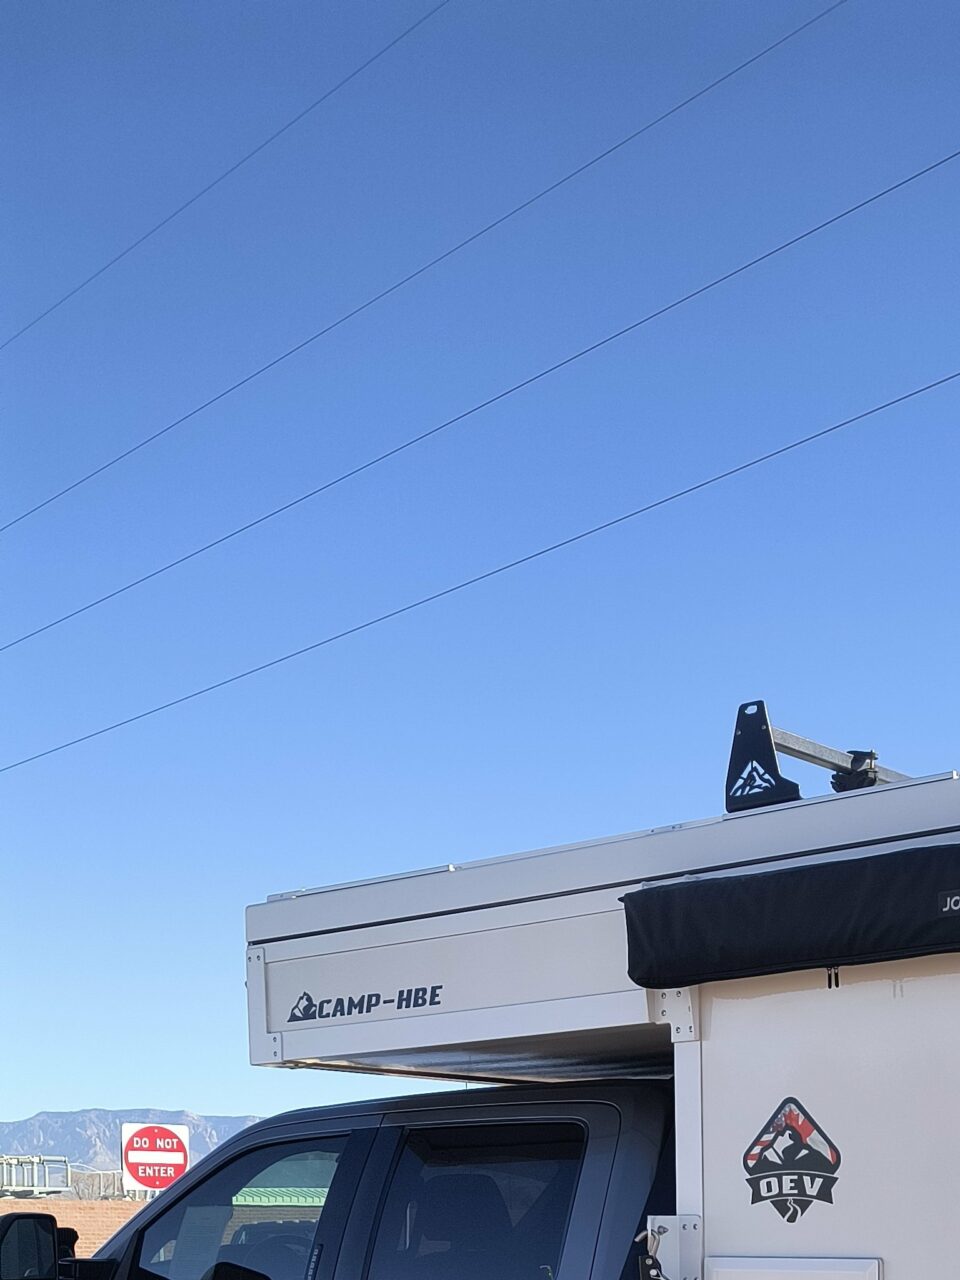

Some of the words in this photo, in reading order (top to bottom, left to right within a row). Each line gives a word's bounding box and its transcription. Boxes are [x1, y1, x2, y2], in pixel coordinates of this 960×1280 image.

[318, 985, 443, 1018] CAMP-HBE
[133, 1137, 149, 1148] DO
[156, 1138, 179, 1149] NOT
[138, 1166, 175, 1177] ENTER
[760, 1175, 824, 1197] OEV
